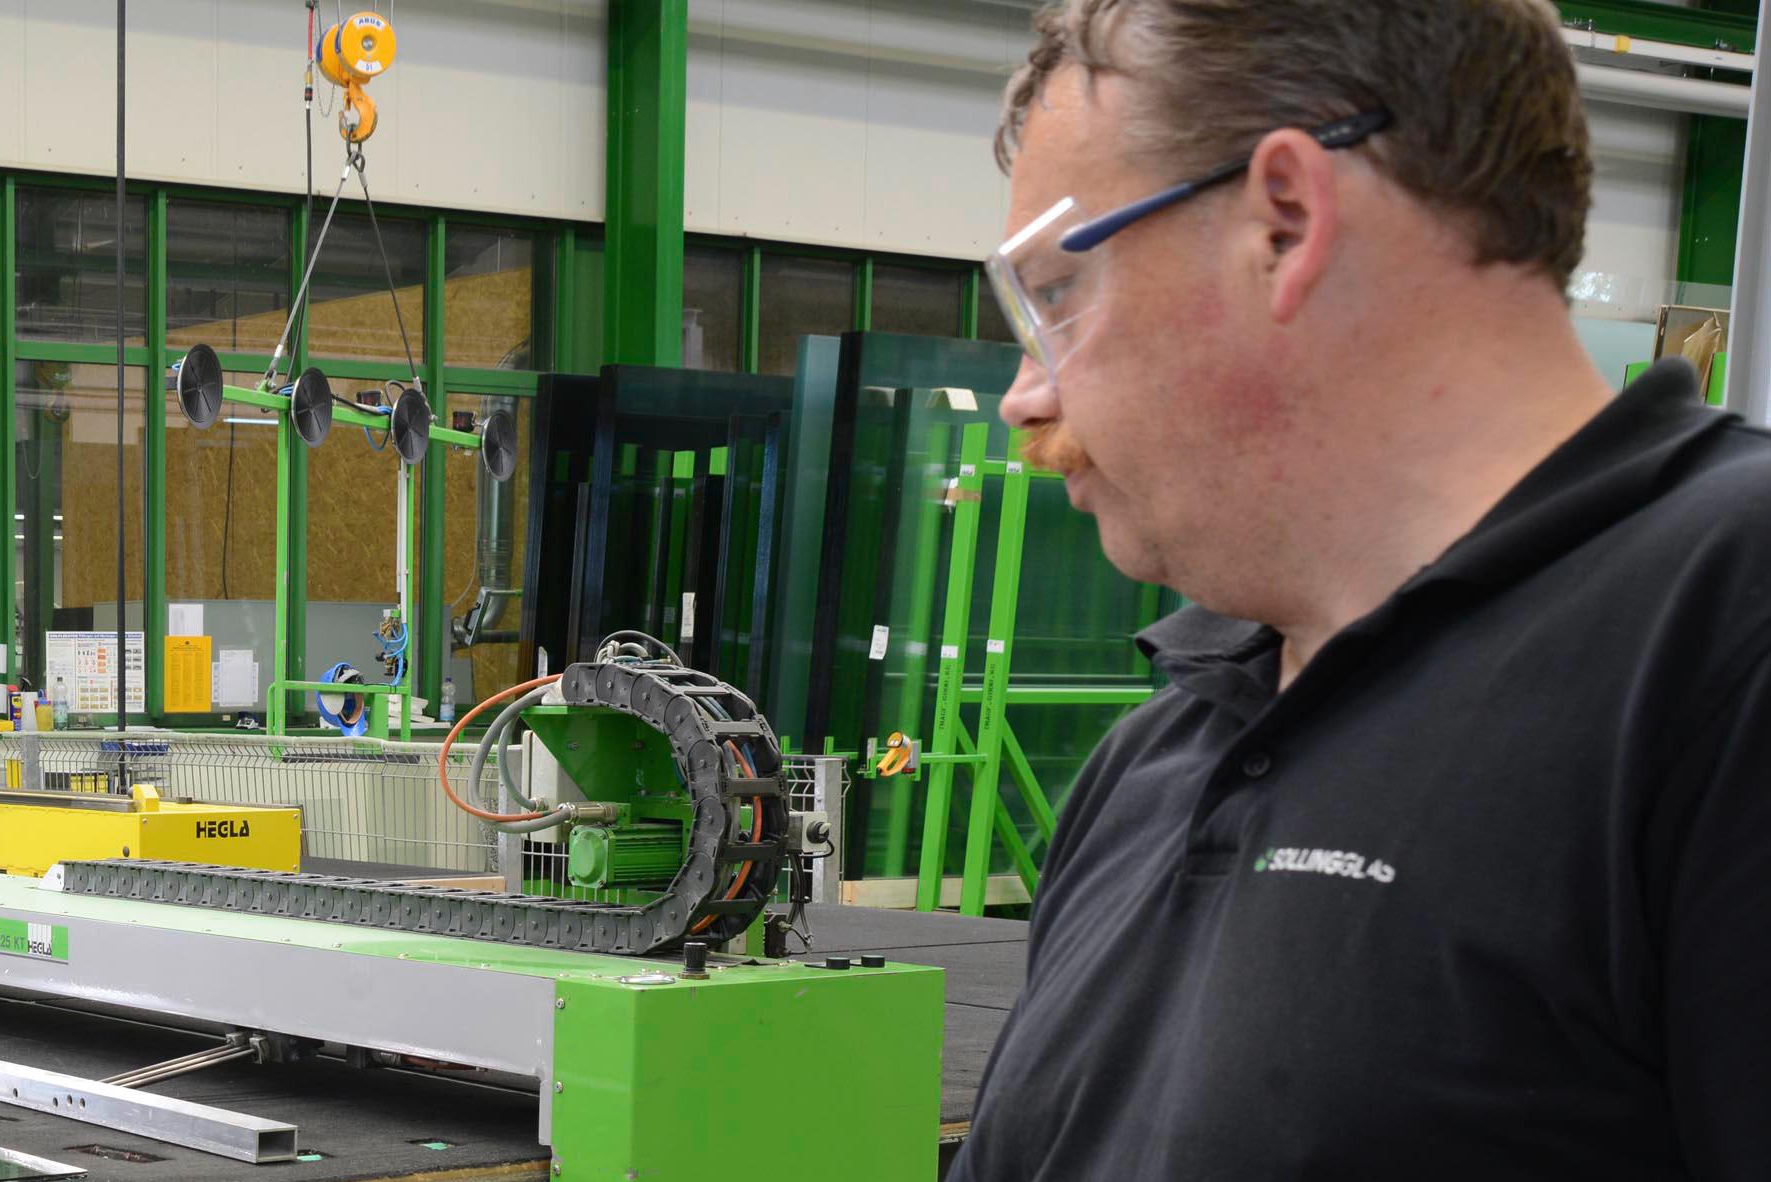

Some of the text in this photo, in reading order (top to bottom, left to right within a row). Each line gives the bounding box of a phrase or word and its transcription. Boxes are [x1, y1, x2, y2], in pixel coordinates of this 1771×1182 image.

[196, 820, 250, 839] HEGLA
[14, 935, 26, 951] KT
[28, 940, 52, 955] HEGLA
